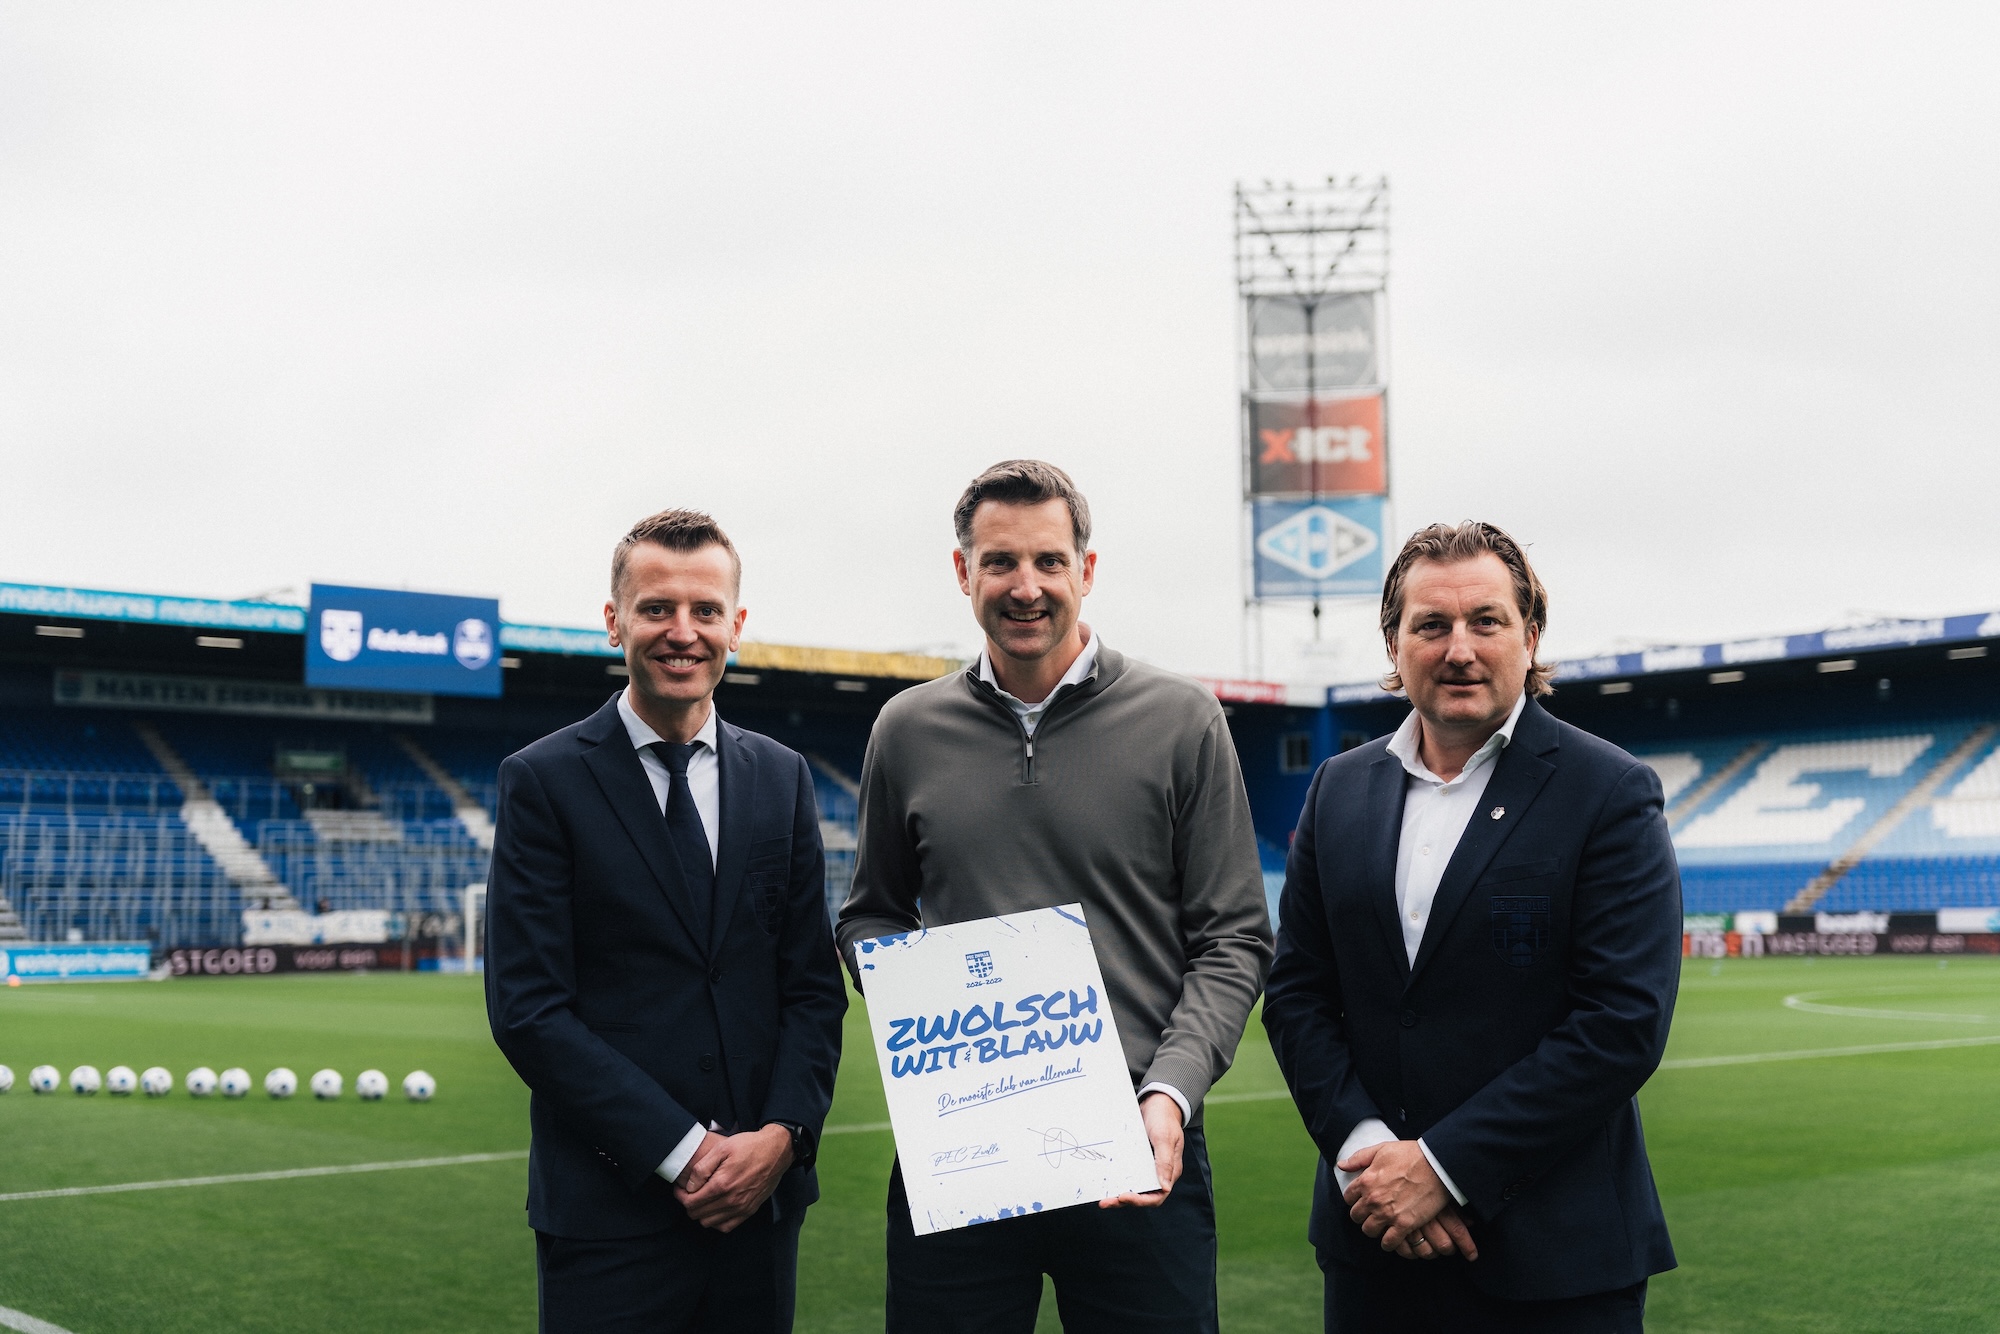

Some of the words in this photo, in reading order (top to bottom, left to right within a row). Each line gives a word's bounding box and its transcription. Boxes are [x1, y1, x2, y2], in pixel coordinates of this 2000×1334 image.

[171, 948, 278, 975] STGOED
[886, 985, 1098, 1052] ZWOLSCH
[891, 1042, 968, 1079] WIT
[963, 1047, 972, 1063] &
[973, 1018, 1103, 1064] BLAUW
[938, 1092, 958, 1112] De
[958, 1082, 995, 1104] mooiste
[995, 1075, 1018, 1094] club
[1019, 1077, 1039, 1089] van
[1039, 1057, 1083, 1081] allemaal
